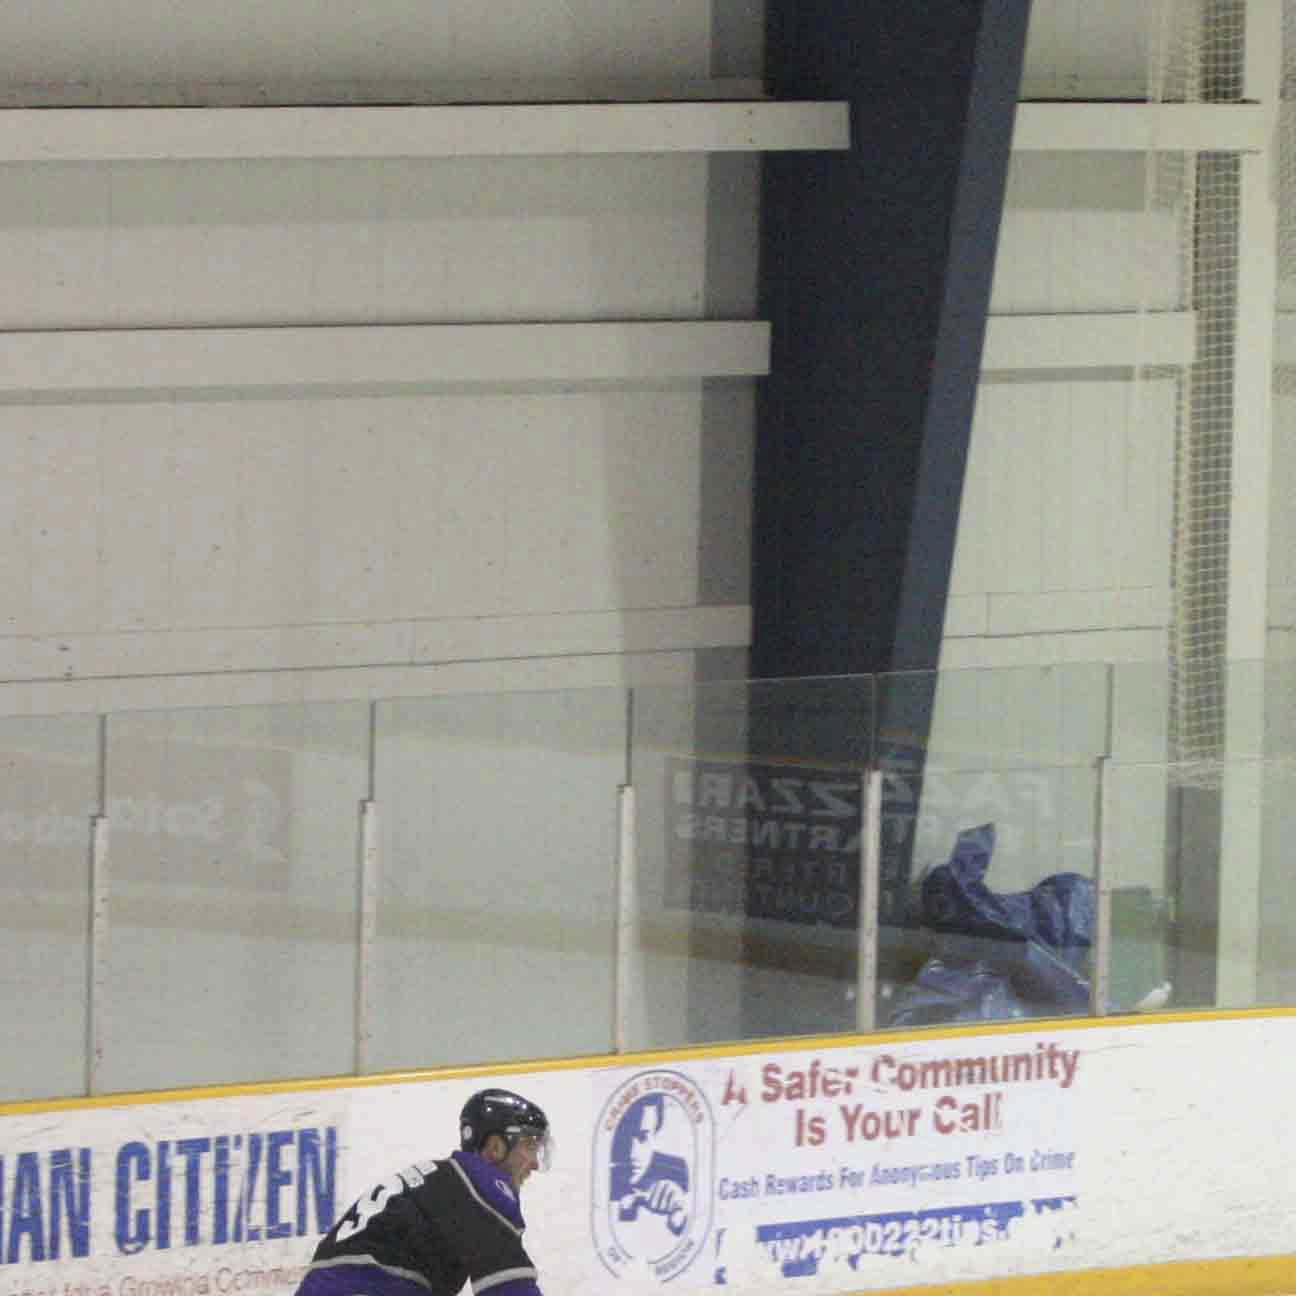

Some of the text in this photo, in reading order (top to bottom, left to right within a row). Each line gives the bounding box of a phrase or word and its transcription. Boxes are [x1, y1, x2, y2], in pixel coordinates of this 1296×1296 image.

[721, 1042, 1081, 1105] A Safer Community
[795, 1091, 1002, 1147] Is Your Call
[115, 1126, 338, 1256] CITIZEN
[719, 1177, 760, 1200] Cash
[765, 1173, 833, 1195] Rewards
[839, 1167, 865, 1189] For
[965, 1154, 998, 1182] Tips
[1004, 1152, 1025, 1175] On
[1030, 1149, 1077, 1173] Crime
